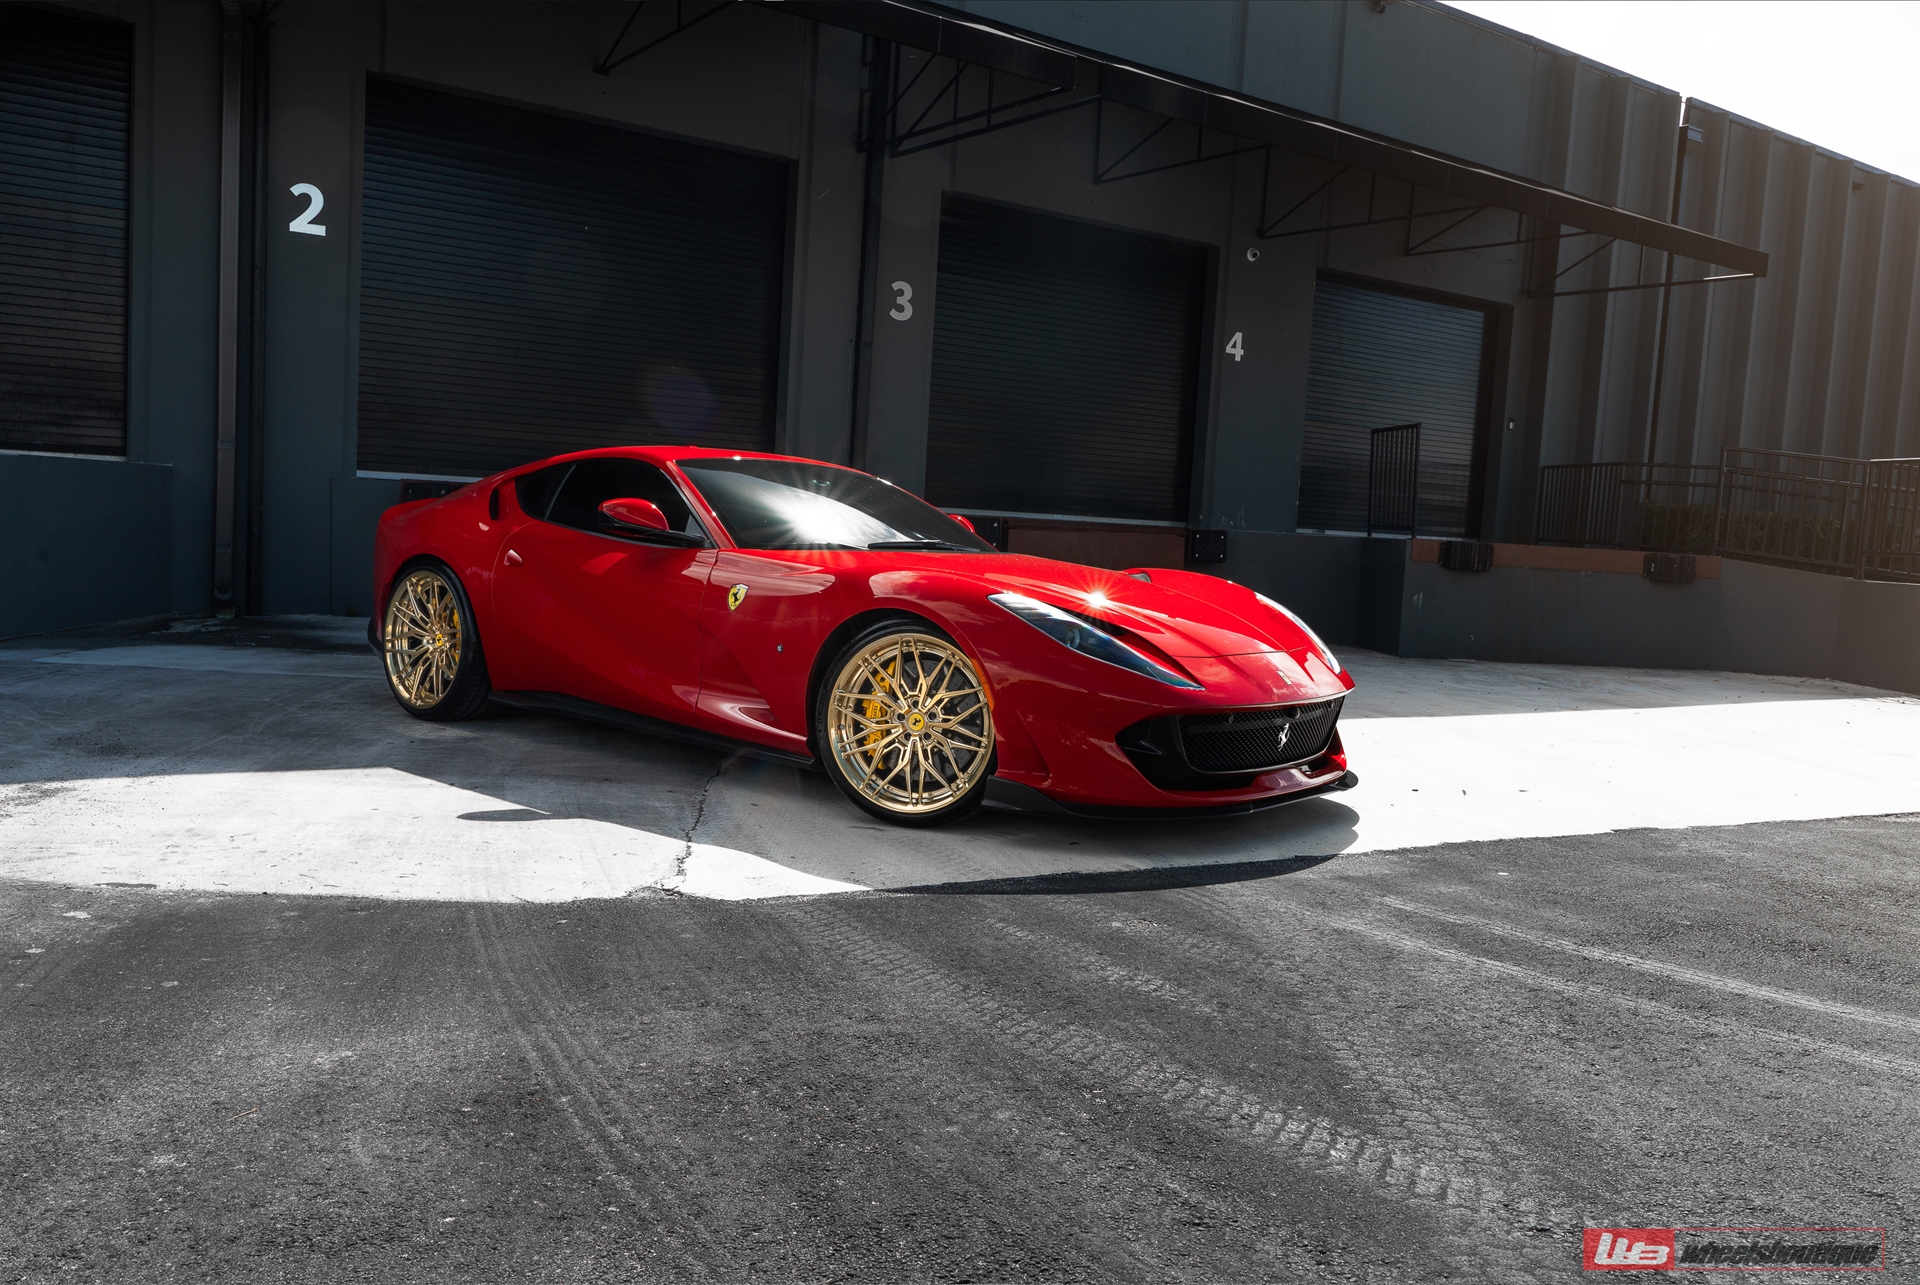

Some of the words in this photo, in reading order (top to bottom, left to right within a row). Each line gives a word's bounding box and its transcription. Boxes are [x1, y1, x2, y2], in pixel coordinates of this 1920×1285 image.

[289, 182, 326, 237] 2
[889, 280, 913, 321] 3
[1225, 331, 1244, 362] 4
